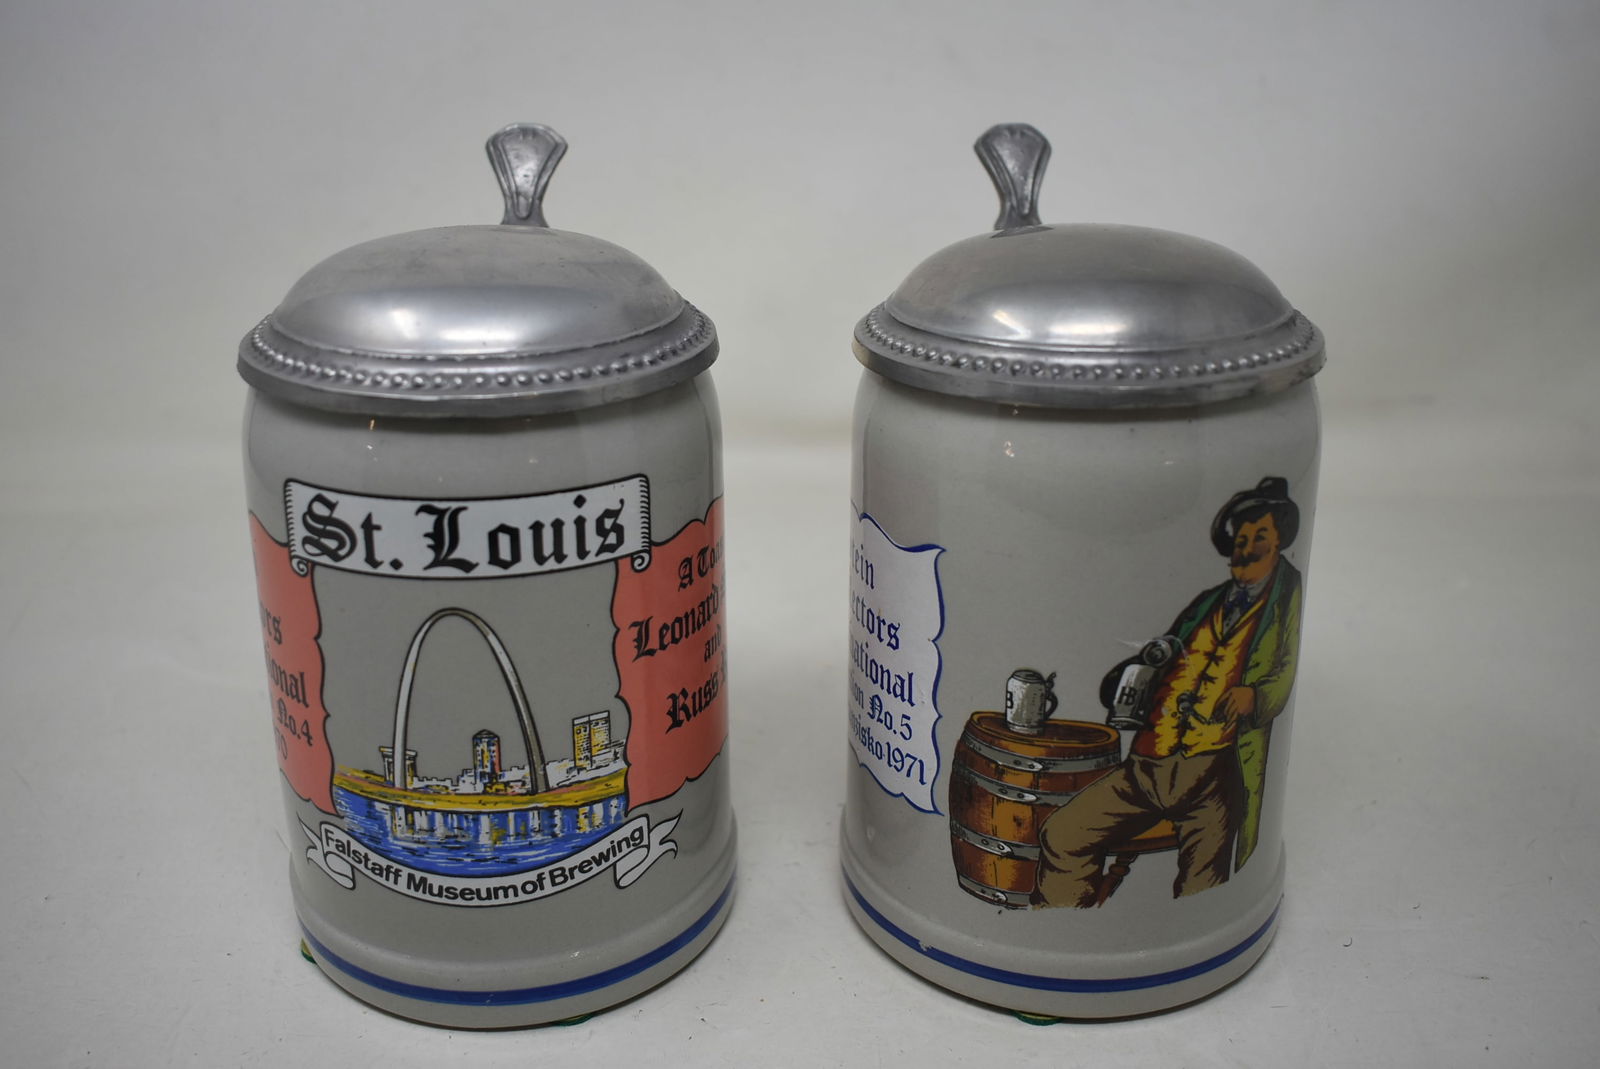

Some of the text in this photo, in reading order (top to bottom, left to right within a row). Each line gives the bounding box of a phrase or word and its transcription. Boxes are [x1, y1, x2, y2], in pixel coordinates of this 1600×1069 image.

[302, 493, 625, 574] St. Louis
[629, 584, 720, 663] Leonard
[665, 671, 719, 734] Russ
[1118, 686, 1138, 706] HB
[323, 825, 645, 902] Falstaff Museum of Brewing
